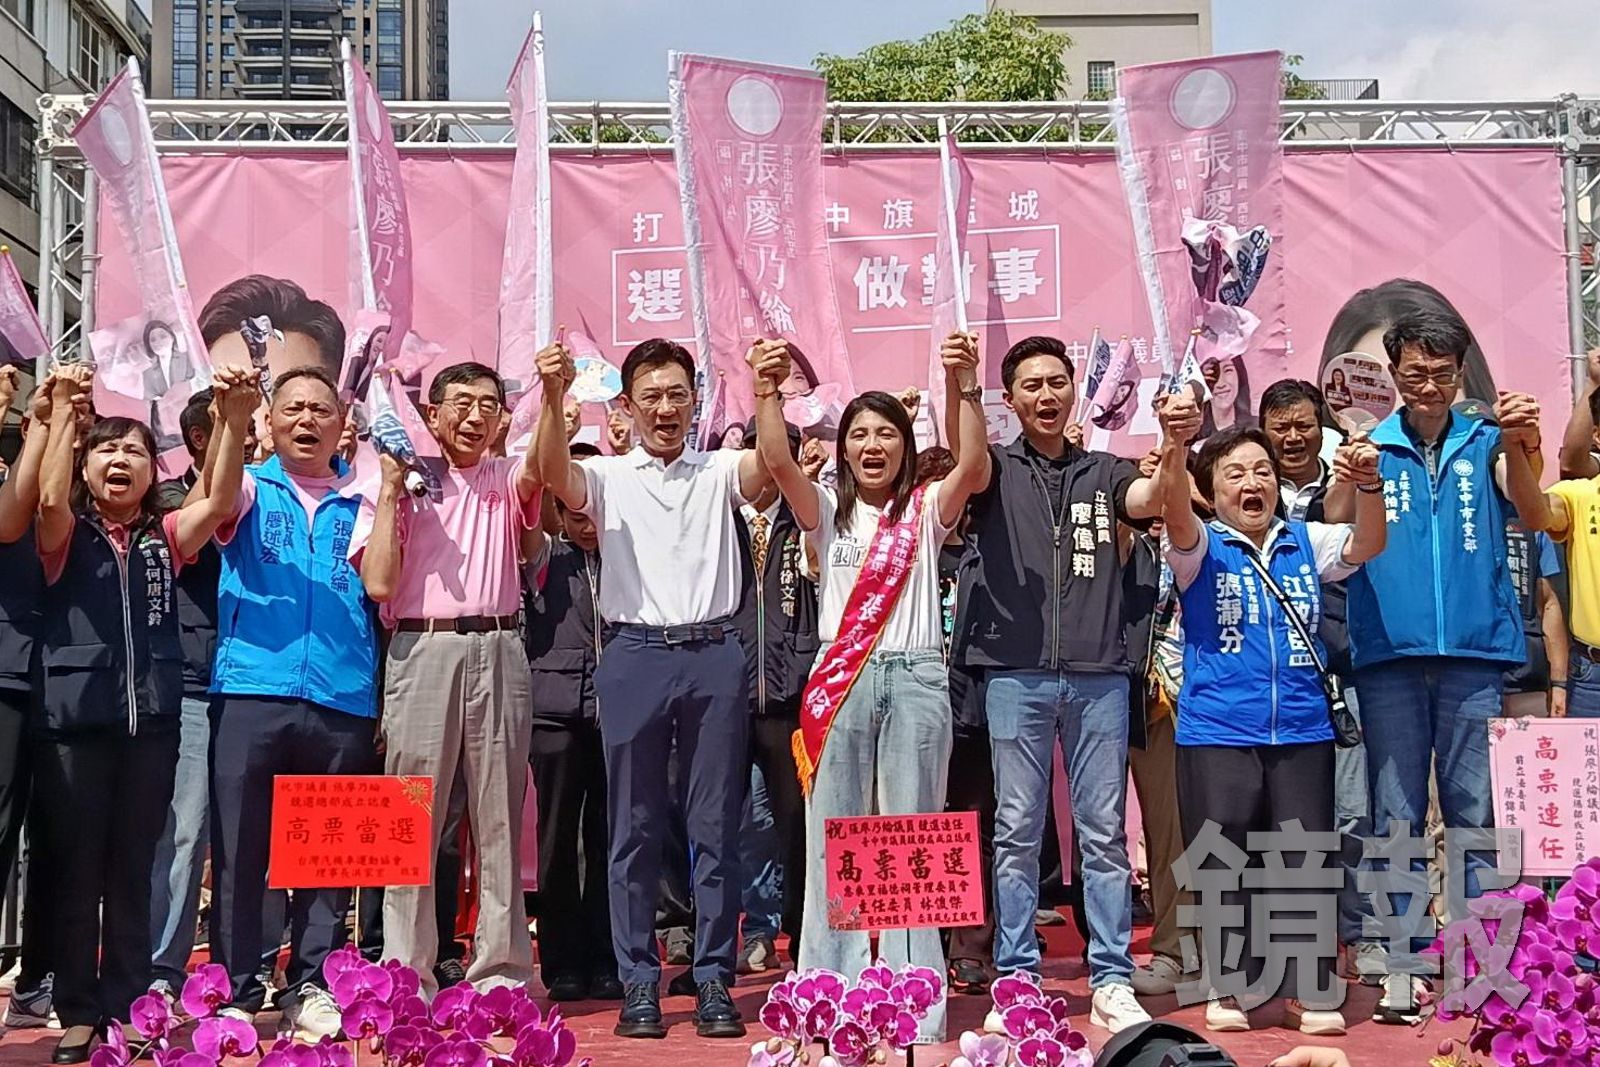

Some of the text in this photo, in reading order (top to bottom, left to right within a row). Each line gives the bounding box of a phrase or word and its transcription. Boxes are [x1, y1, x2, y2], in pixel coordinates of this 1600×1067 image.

[1094, 490, 1111, 543] 立法委員
[1535, 736, 1564, 859] 高票連任
[286, 816, 416, 845] 高票當選
[837, 847, 970, 882] 高票當選
[859, 898, 912, 914] 主任委員
